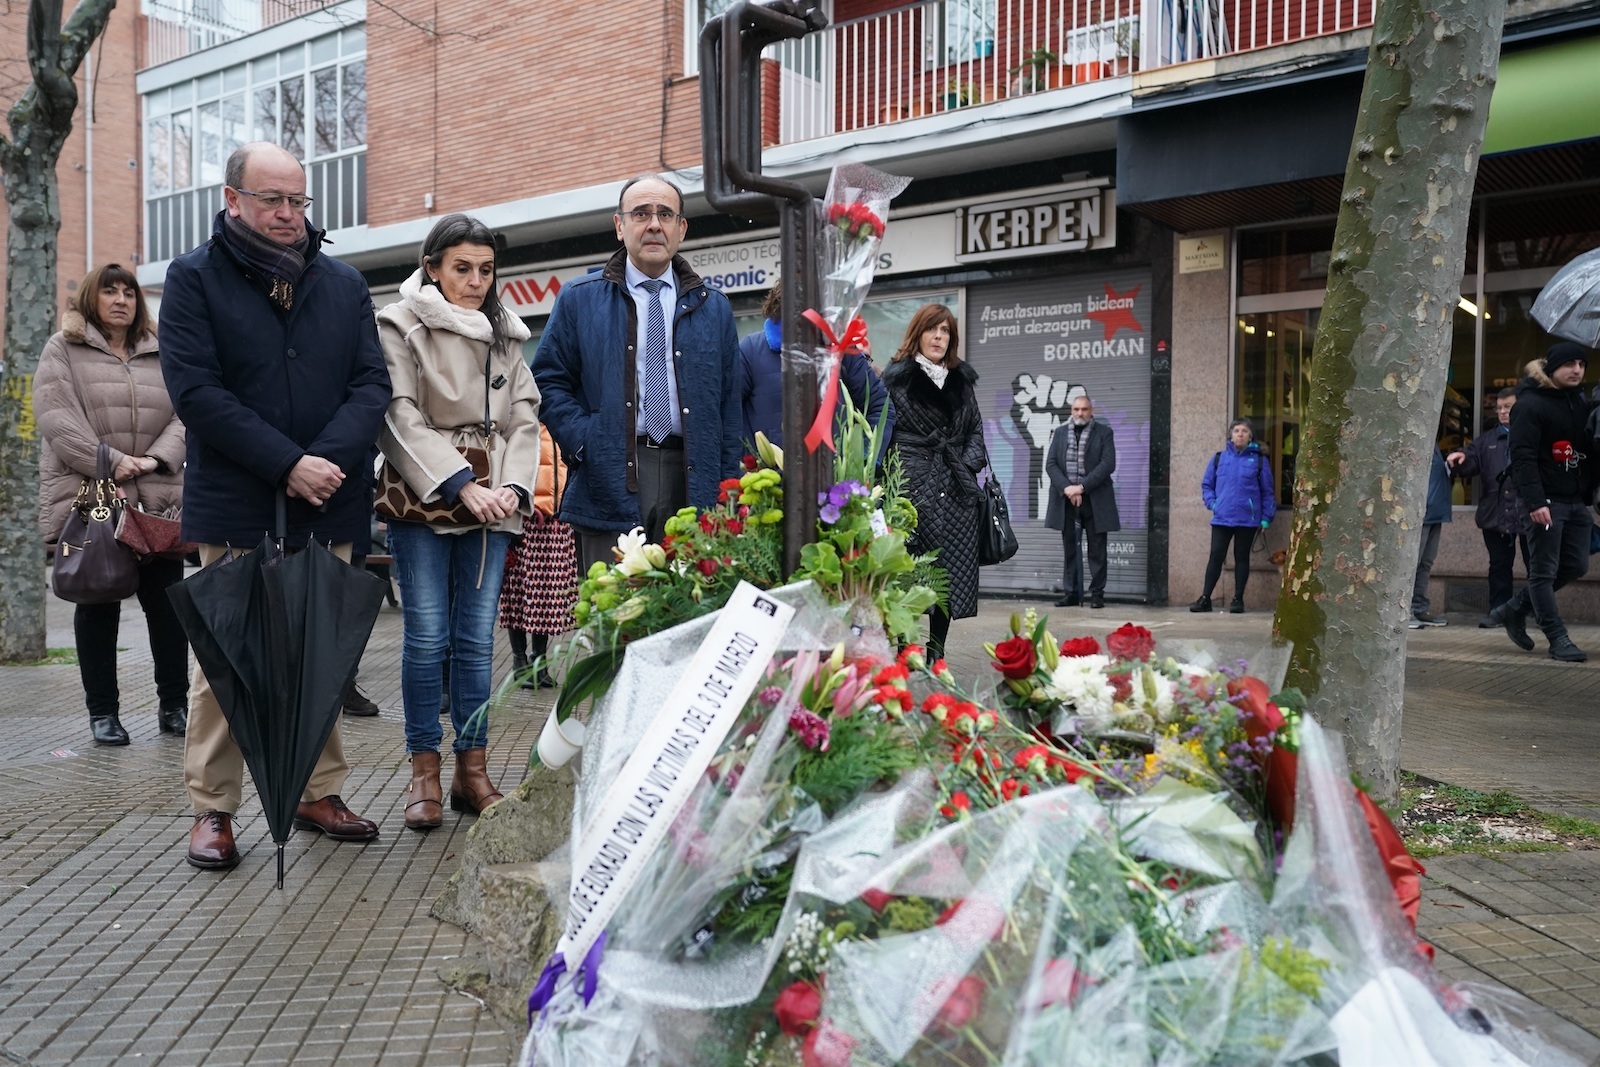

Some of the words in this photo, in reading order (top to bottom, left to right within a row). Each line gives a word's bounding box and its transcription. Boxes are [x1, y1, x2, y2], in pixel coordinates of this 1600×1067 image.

[692, 246, 749, 268] SERVICIO
[980, 303, 1082, 322] Askatasunaren
[1087, 295, 1134, 313] bidean
[979, 320, 1020, 344] jarrai
[1024, 319, 1091, 337] dezagun
[1044, 337, 1144, 362] BORROKAN
[715, 631, 758, 680] MARZO
[704, 674, 732, 698] DE
[698, 693, 721, 708] 3
[682, 705, 715, 734] DEL
[645, 728, 699, 791] VICTIMAS
[629, 786, 663, 818] LAS
[613, 811, 648, 844] CON
[581, 838, 631, 896] EUSKADI
[573, 887, 597, 913] DE
